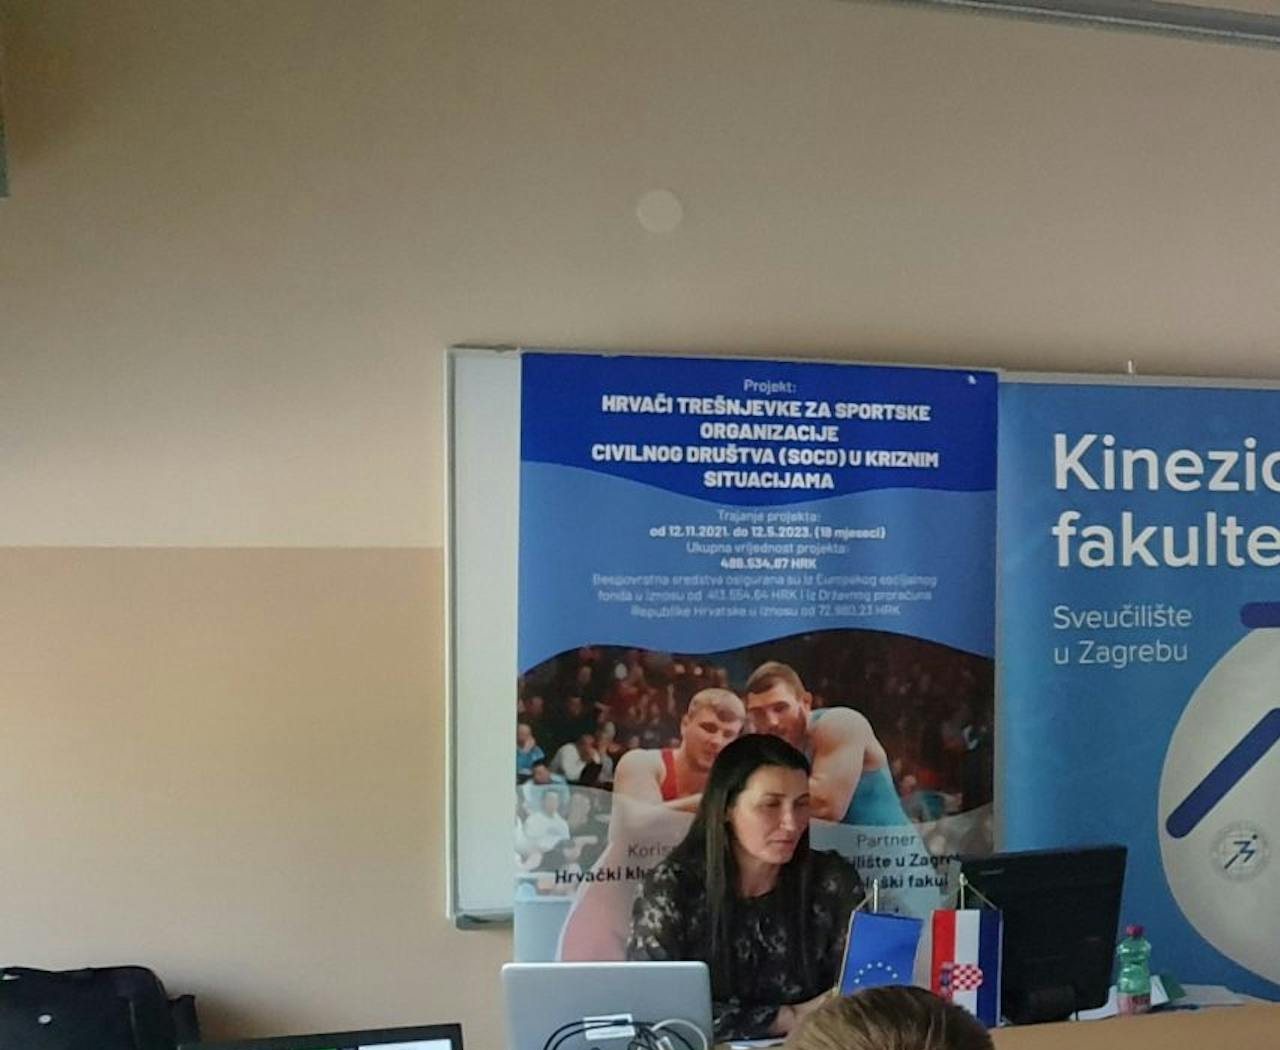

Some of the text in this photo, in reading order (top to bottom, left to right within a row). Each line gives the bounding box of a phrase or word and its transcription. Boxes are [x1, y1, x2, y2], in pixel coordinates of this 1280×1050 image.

[743, 378, 797, 396] Projekt:
[602, 393, 931, 422] HRVAČI TREŠNJEVKE ZA SPORTSKE
[700, 422, 839, 442] ORGANIZACIJE
[592, 444, 939, 469] CIVILNOG DRUŠTVA (SOCD) U KRIZNIM
[703, 470, 835, 489] SITUACIJAMA
[650, 525, 667, 537] od
[732, 526, 749, 538] do
[686, 541, 732, 555] Ukupna
[1053, 604, 1192, 630] Sveučilište
[1053, 639, 1188, 669] u Zagrebu
[857, 834, 916, 848] Partner
